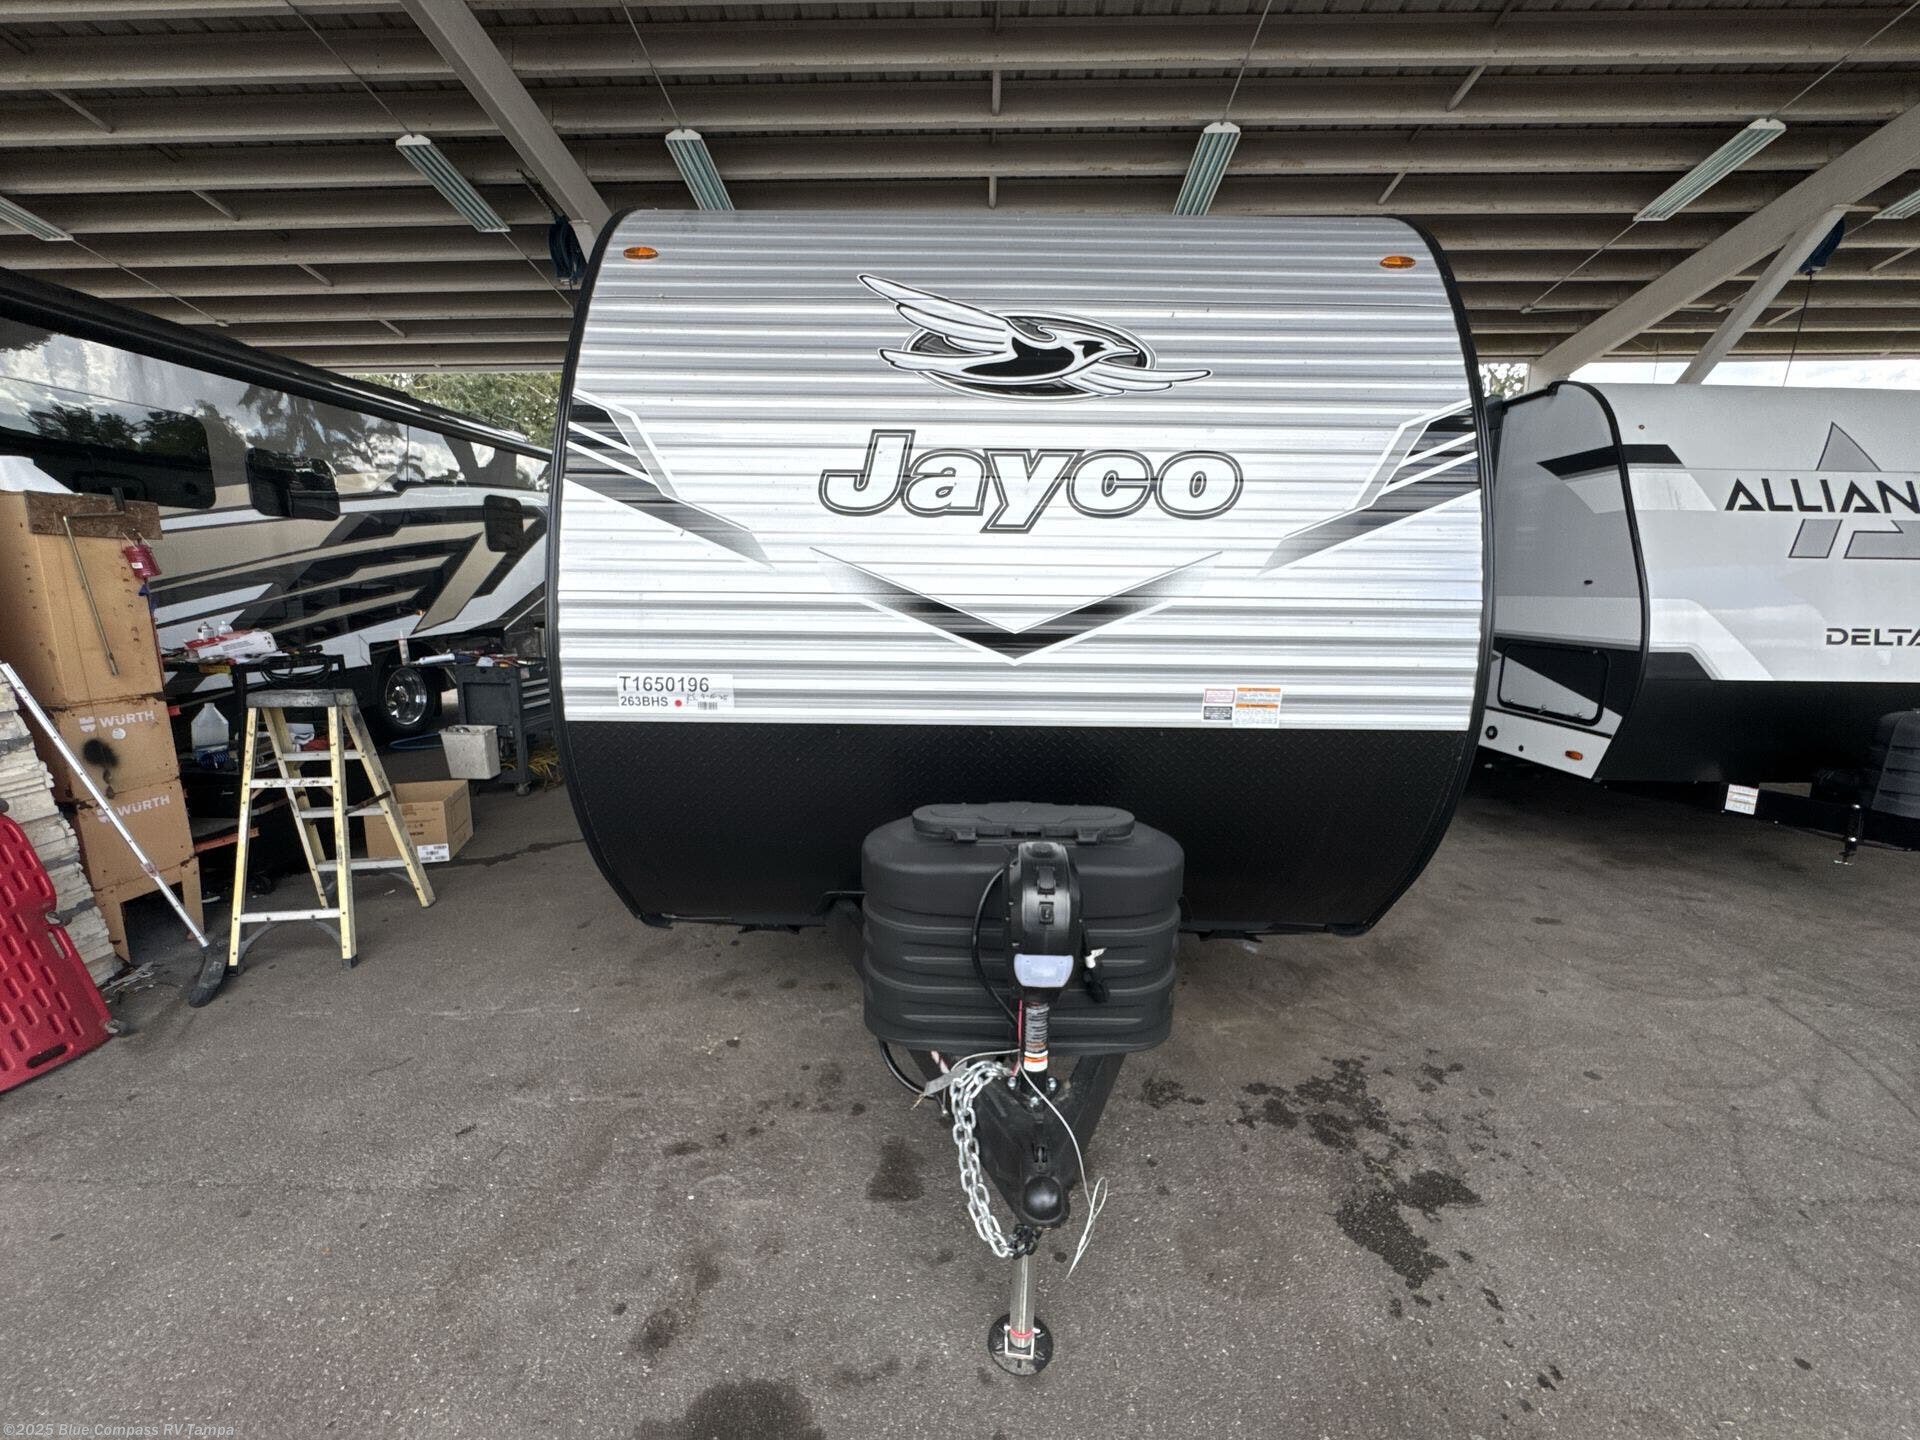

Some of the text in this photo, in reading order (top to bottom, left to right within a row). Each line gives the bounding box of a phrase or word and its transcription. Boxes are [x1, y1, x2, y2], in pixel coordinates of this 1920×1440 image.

[818, 429, 1243, 534] Jayco
[619, 676, 709, 692] T1650196
[620, 696, 668, 707] 263BHS
